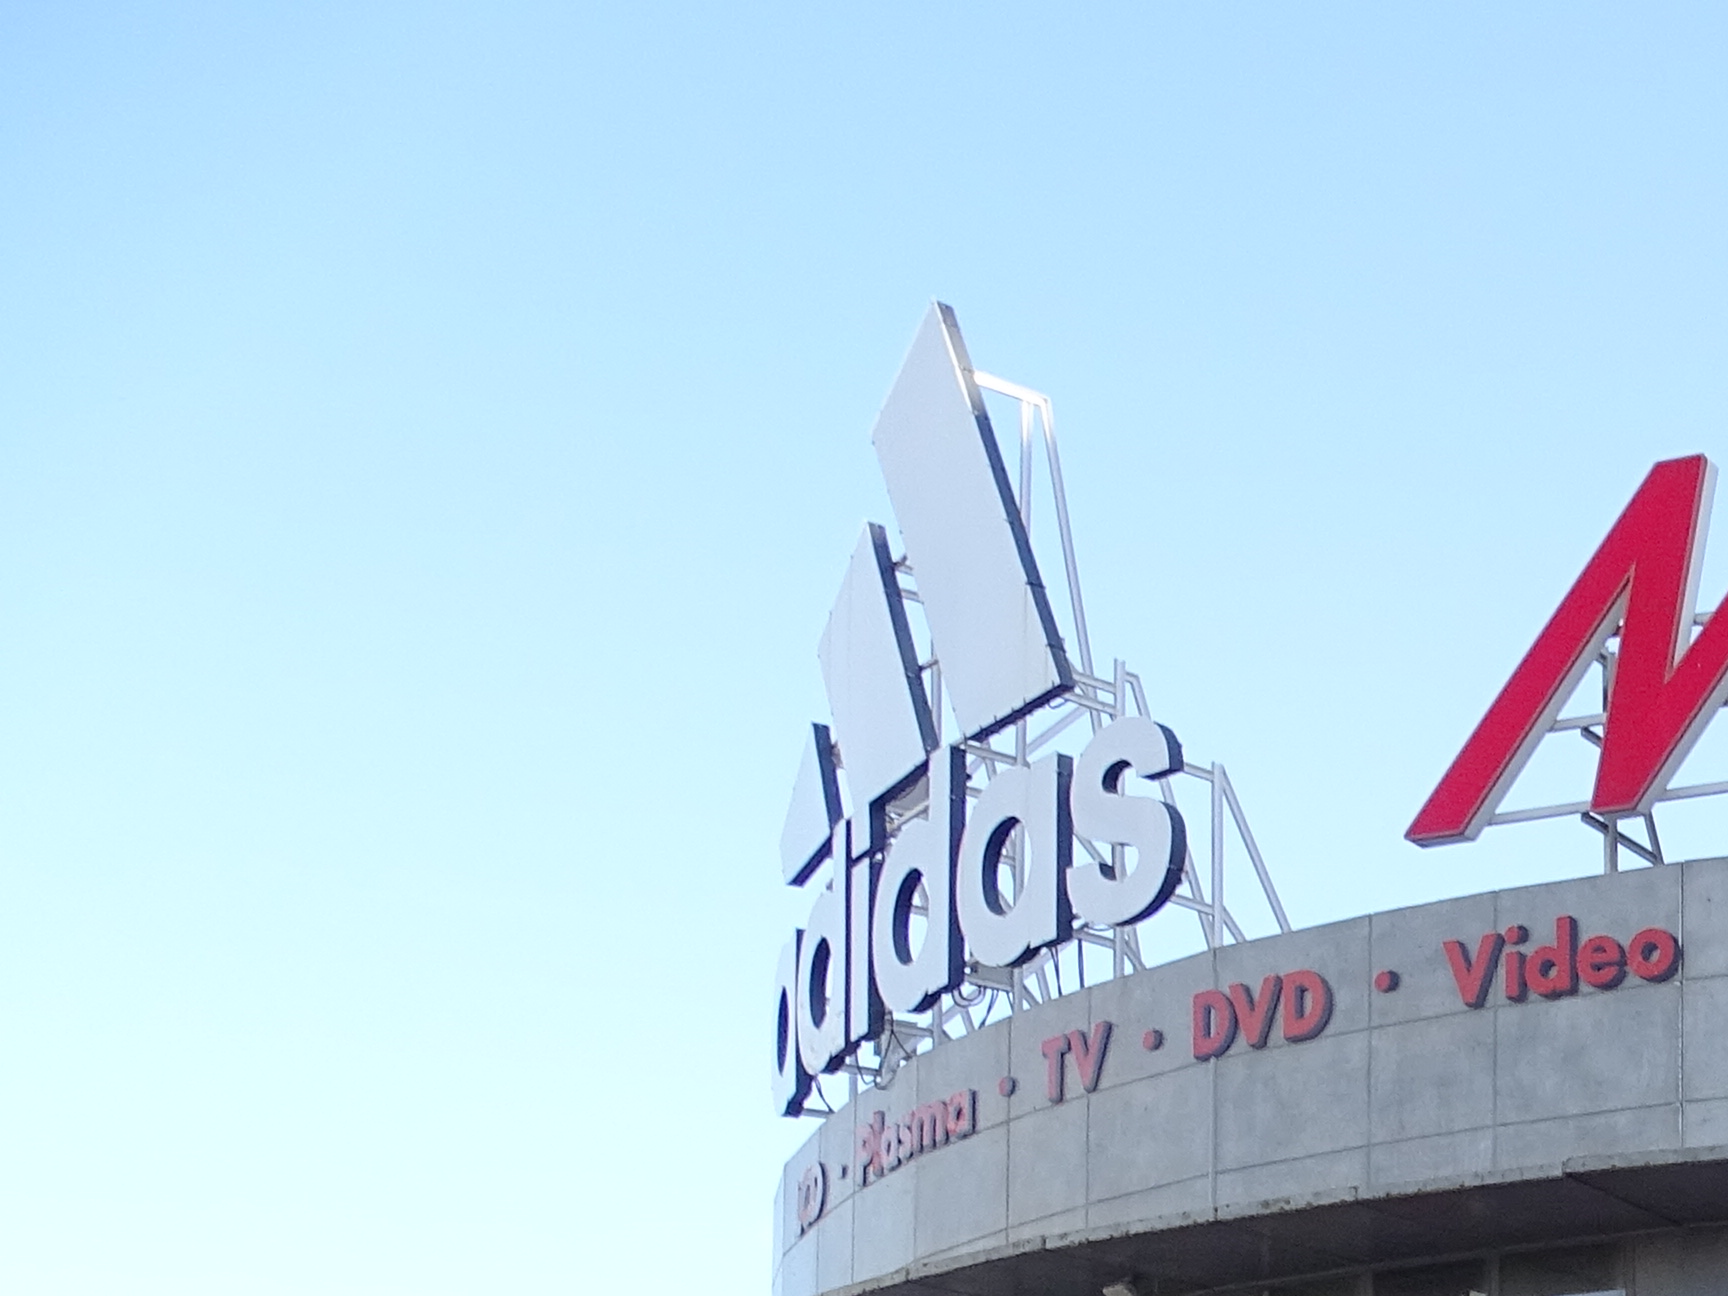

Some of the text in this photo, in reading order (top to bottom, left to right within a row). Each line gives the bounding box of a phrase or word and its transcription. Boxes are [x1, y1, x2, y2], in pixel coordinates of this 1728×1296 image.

[771, 716, 1186, 1117] adidas
[856, 1088, 976, 1187] Plasma
[1041, 1021, 1112, 1103] TV
[1193, 969, 1334, 1061] DVD
[1443, 916, 1683, 1010] Video
